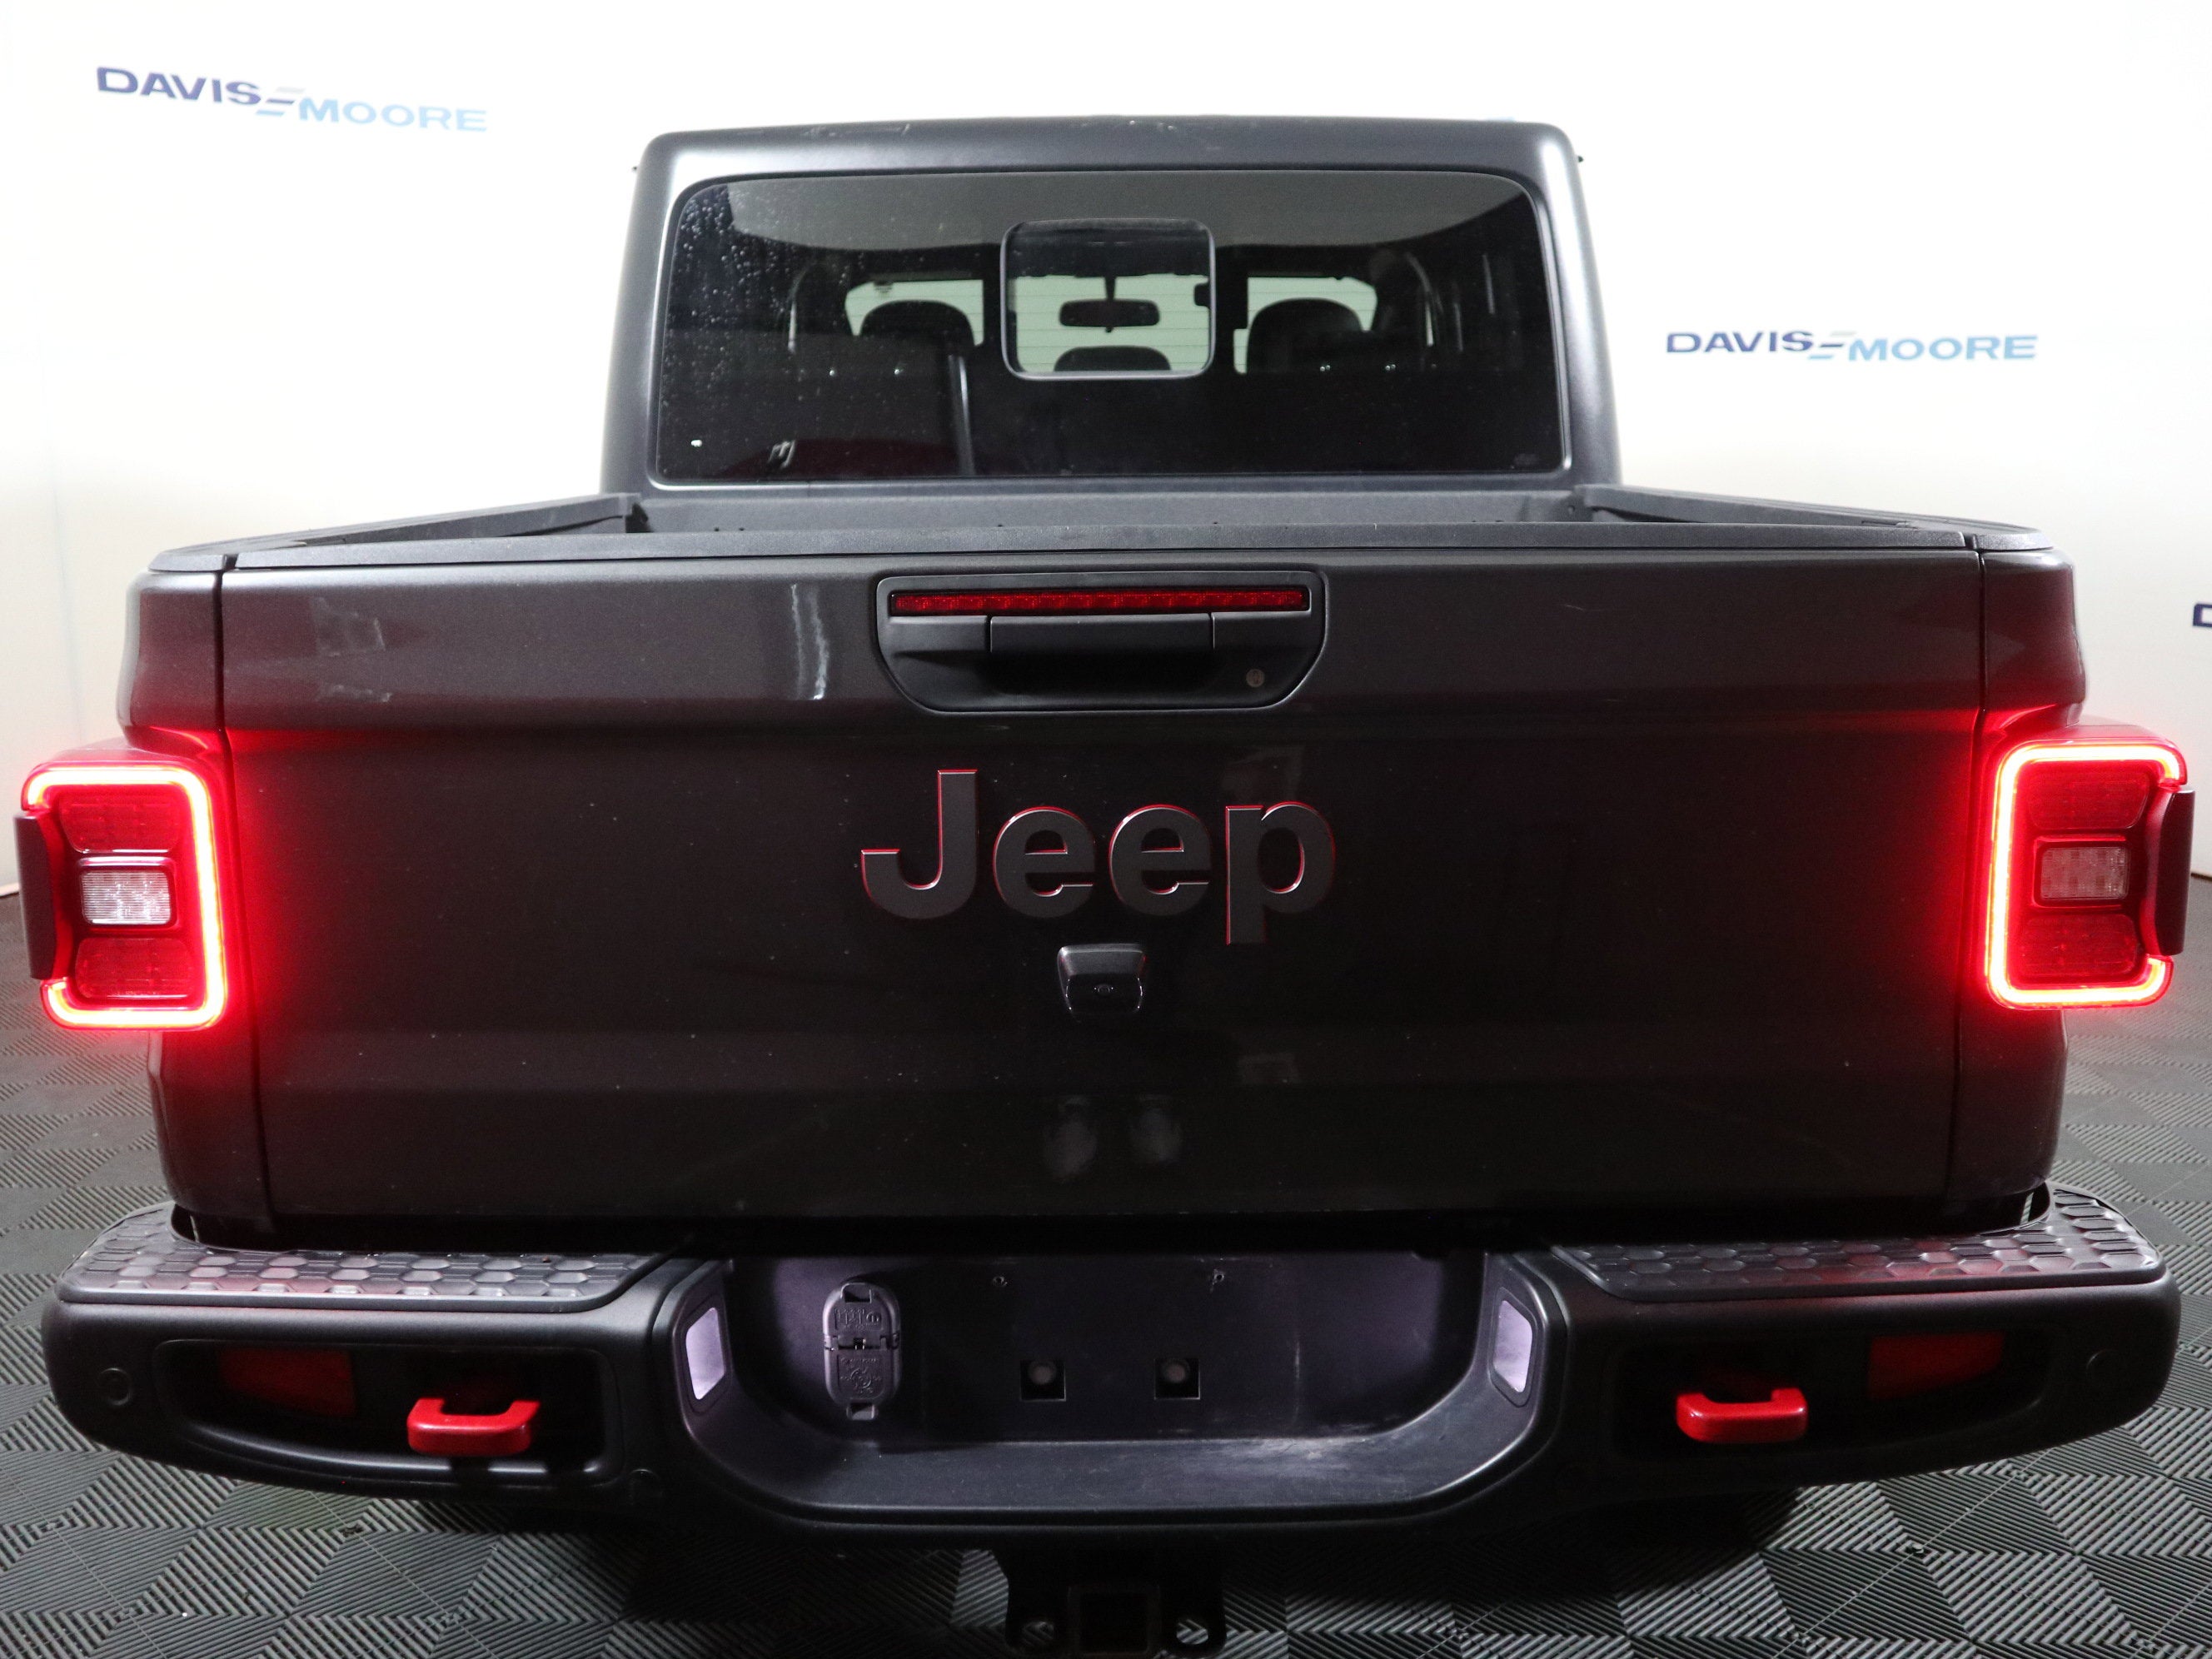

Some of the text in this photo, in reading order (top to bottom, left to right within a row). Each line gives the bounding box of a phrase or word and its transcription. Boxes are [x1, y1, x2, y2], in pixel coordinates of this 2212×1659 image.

[96, 67, 488, 132] DAVIS MOORE
[1666, 330, 2038, 361] DAVIS MOORE
[860, 768, 1336, 945] Jeep
